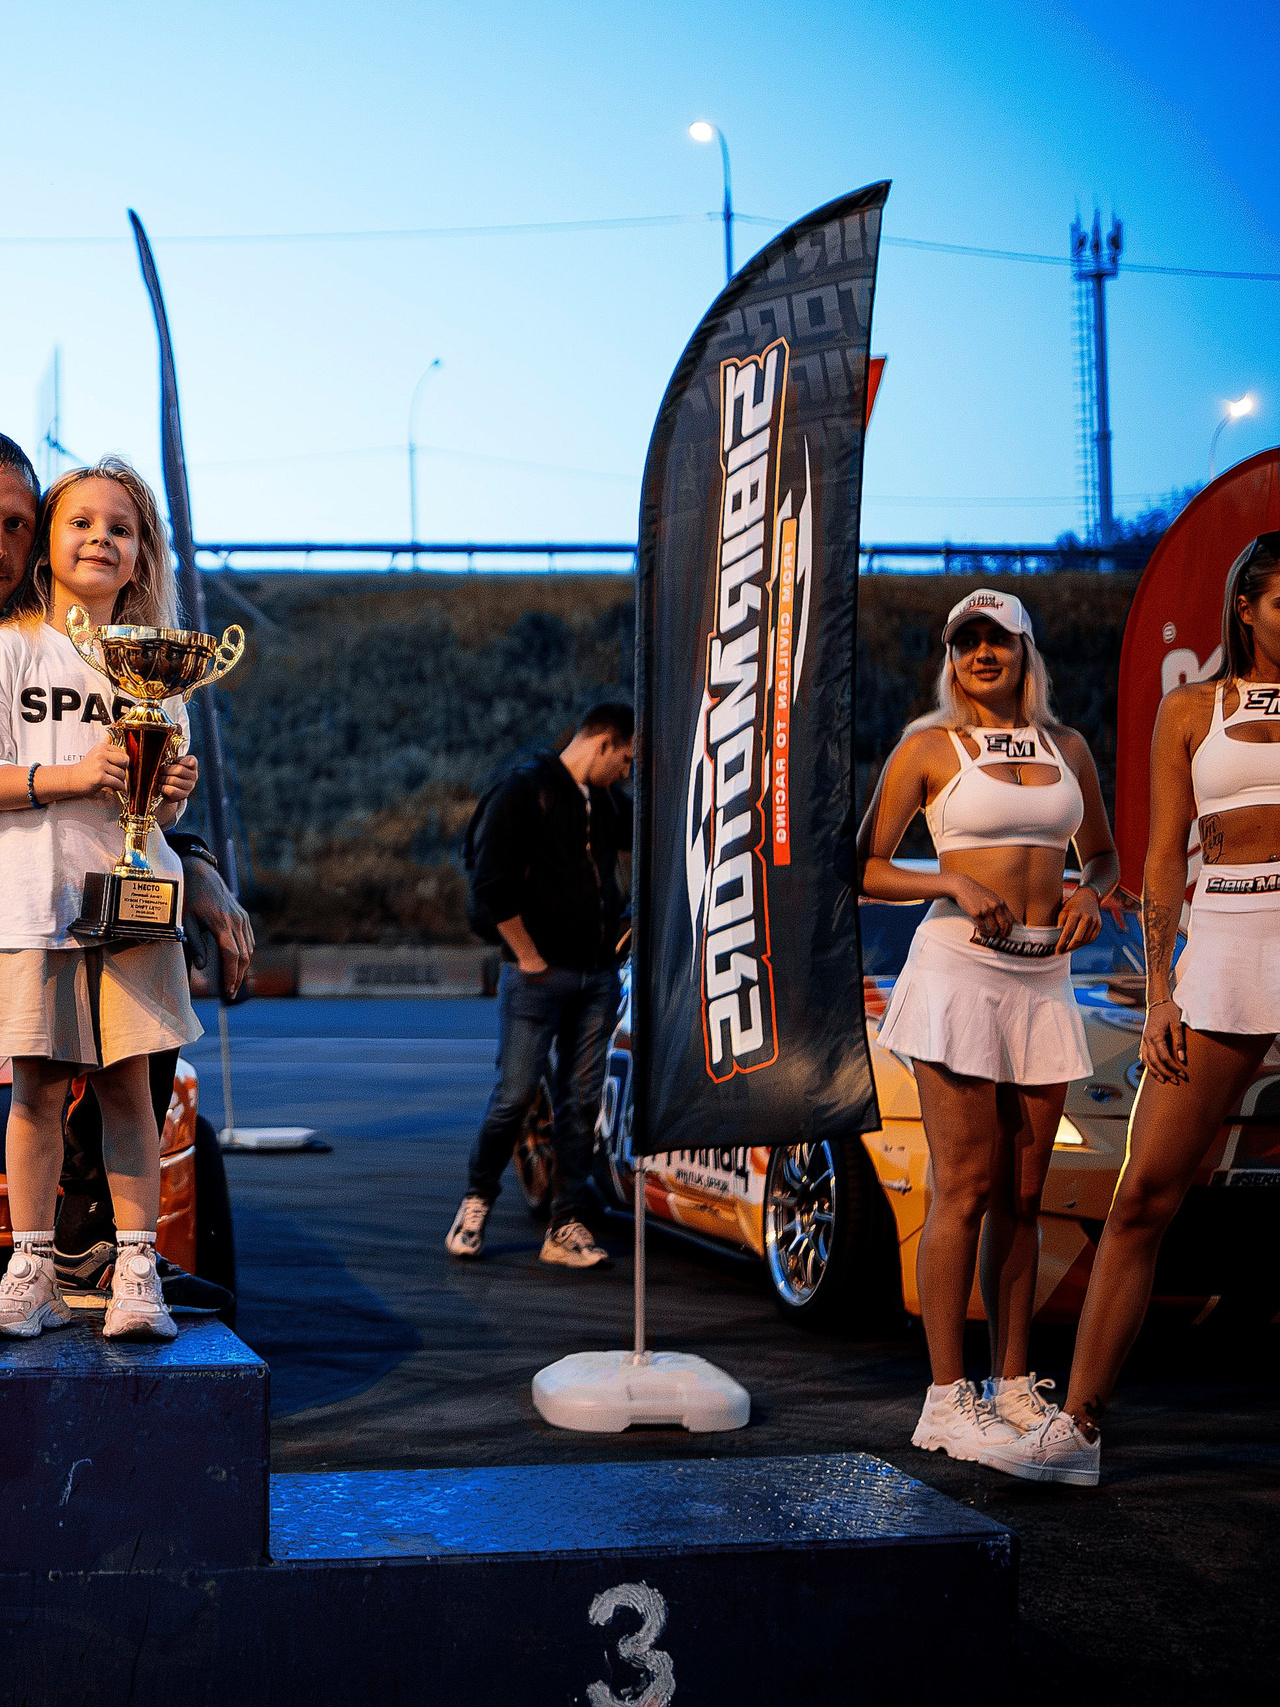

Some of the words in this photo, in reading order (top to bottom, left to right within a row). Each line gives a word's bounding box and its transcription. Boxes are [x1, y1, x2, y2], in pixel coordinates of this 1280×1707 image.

[138, 883, 160, 892] МЕСТО
[1206, 876, 1280, 894] SIBIRM
[586, 1580, 677, 1707] 3
